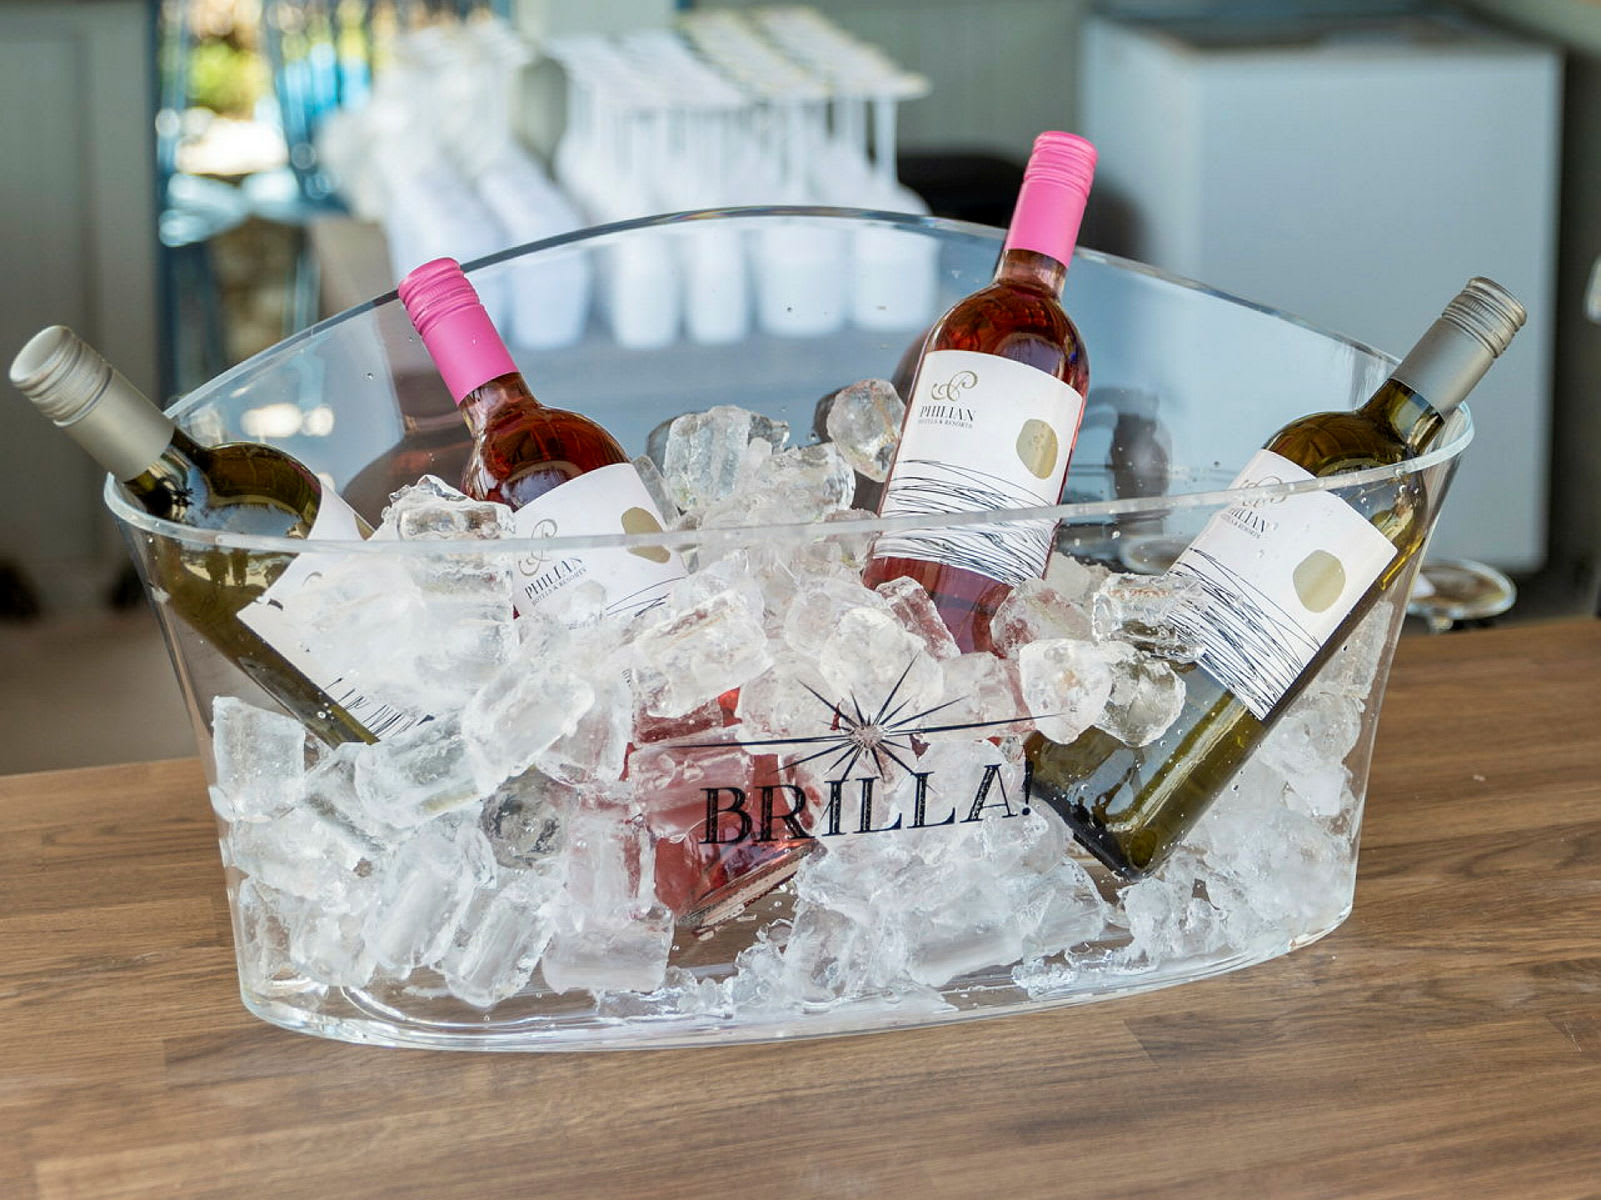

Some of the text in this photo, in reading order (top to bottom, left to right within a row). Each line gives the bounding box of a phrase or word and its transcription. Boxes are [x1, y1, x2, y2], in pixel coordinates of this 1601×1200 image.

[919, 404, 975, 422] PHILIAN
[524, 557, 583, 600] PHILIAN
[698, 760, 1035, 845] BRILLA!
